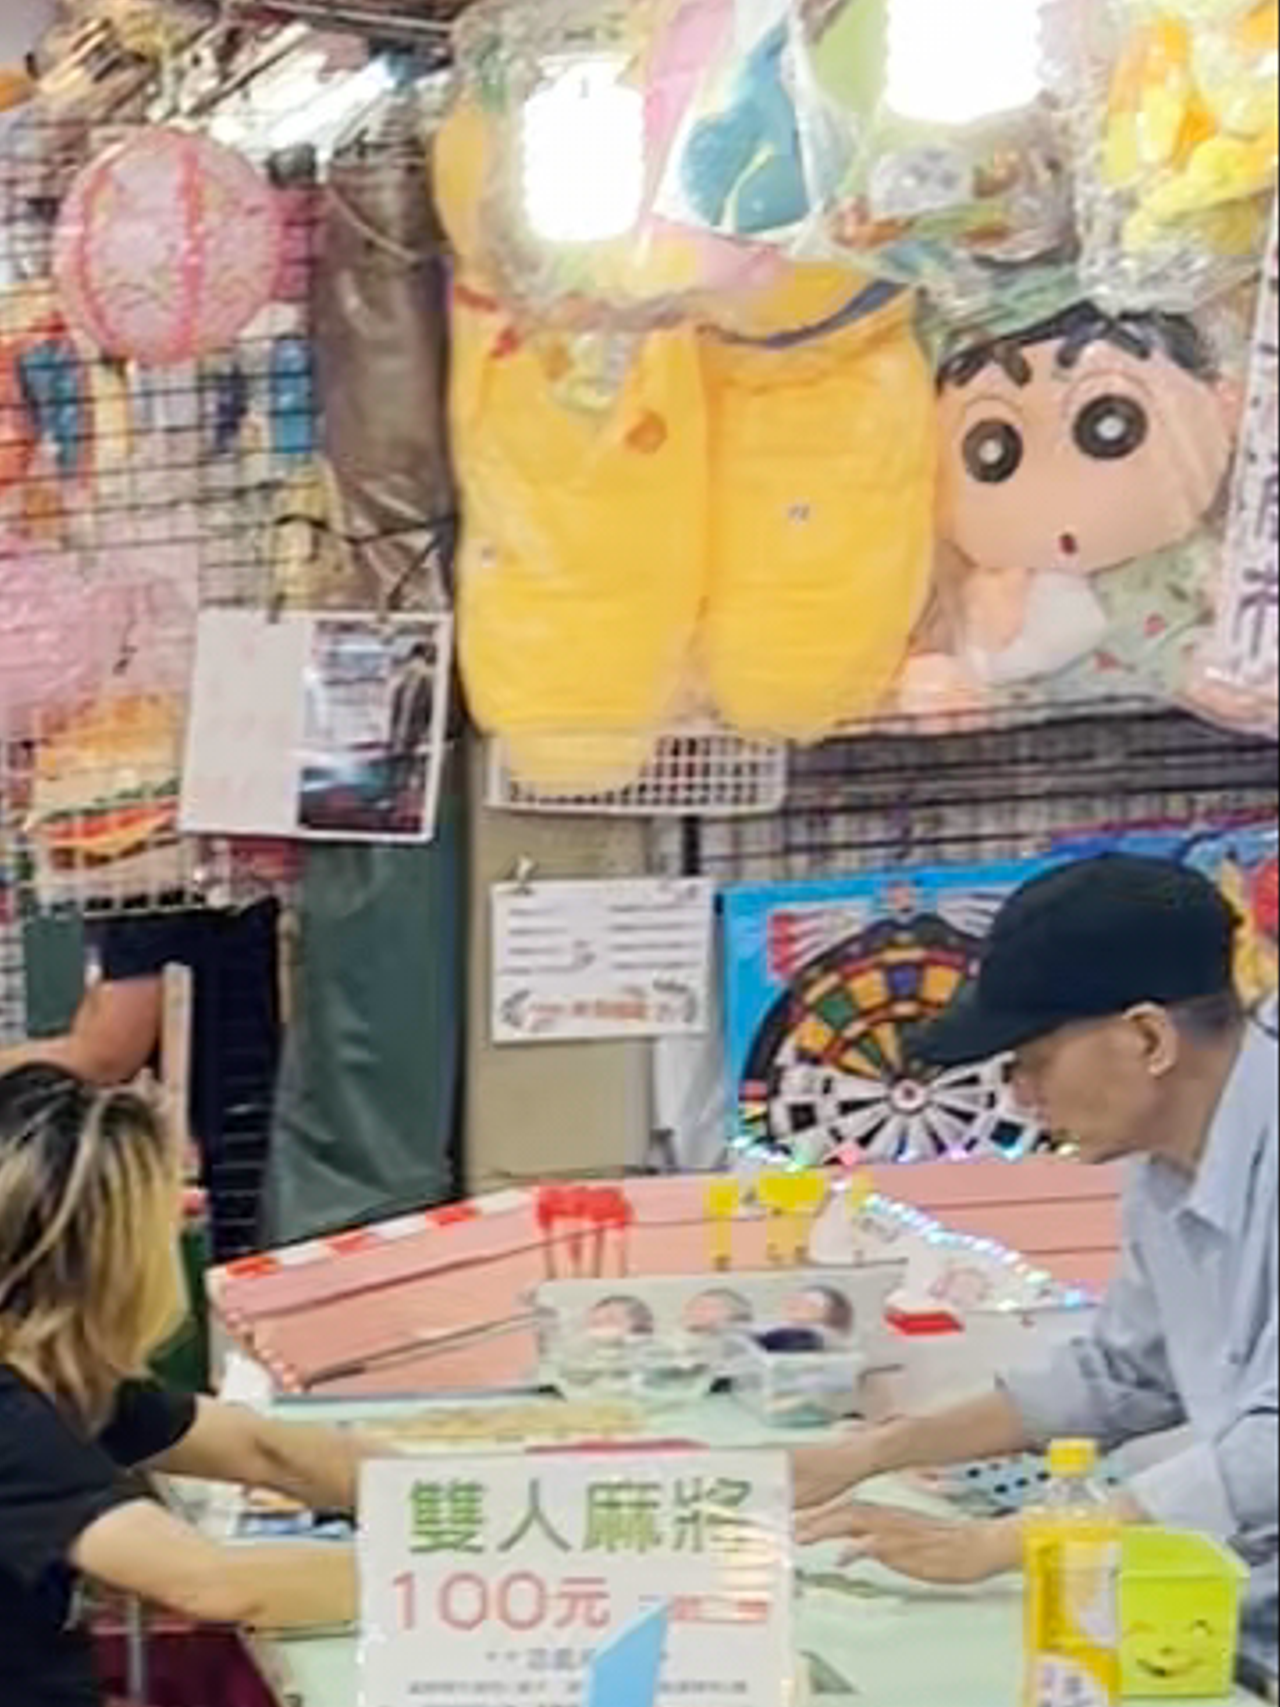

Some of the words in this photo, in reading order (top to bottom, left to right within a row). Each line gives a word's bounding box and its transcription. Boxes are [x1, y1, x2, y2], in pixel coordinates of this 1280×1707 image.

[408, 1477, 752, 1555] 雙人麻將
[391, 1569, 612, 1632] 100元
